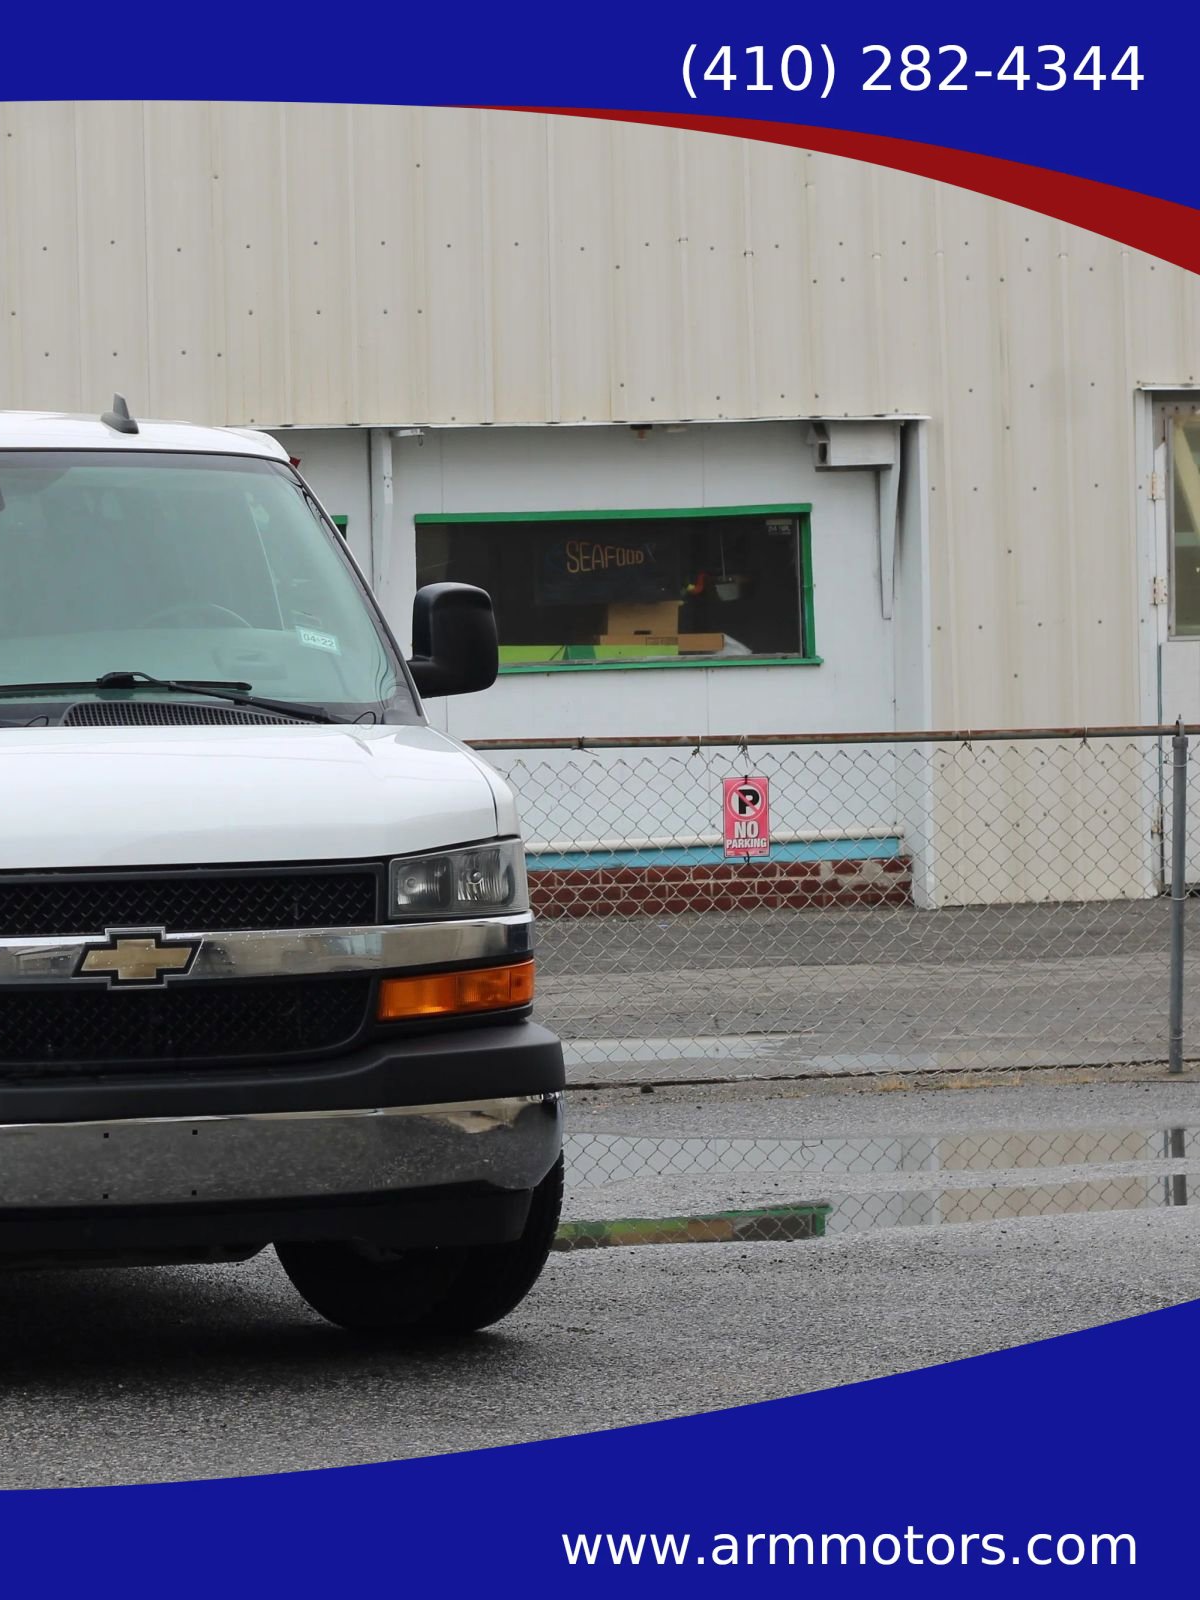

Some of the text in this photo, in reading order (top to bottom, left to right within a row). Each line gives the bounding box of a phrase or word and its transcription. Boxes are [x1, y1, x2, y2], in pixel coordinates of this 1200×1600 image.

[566, 540, 644, 573] SEAFOOD
[734, 820, 759, 838] NO
[726, 838, 767, 849] PARKING
